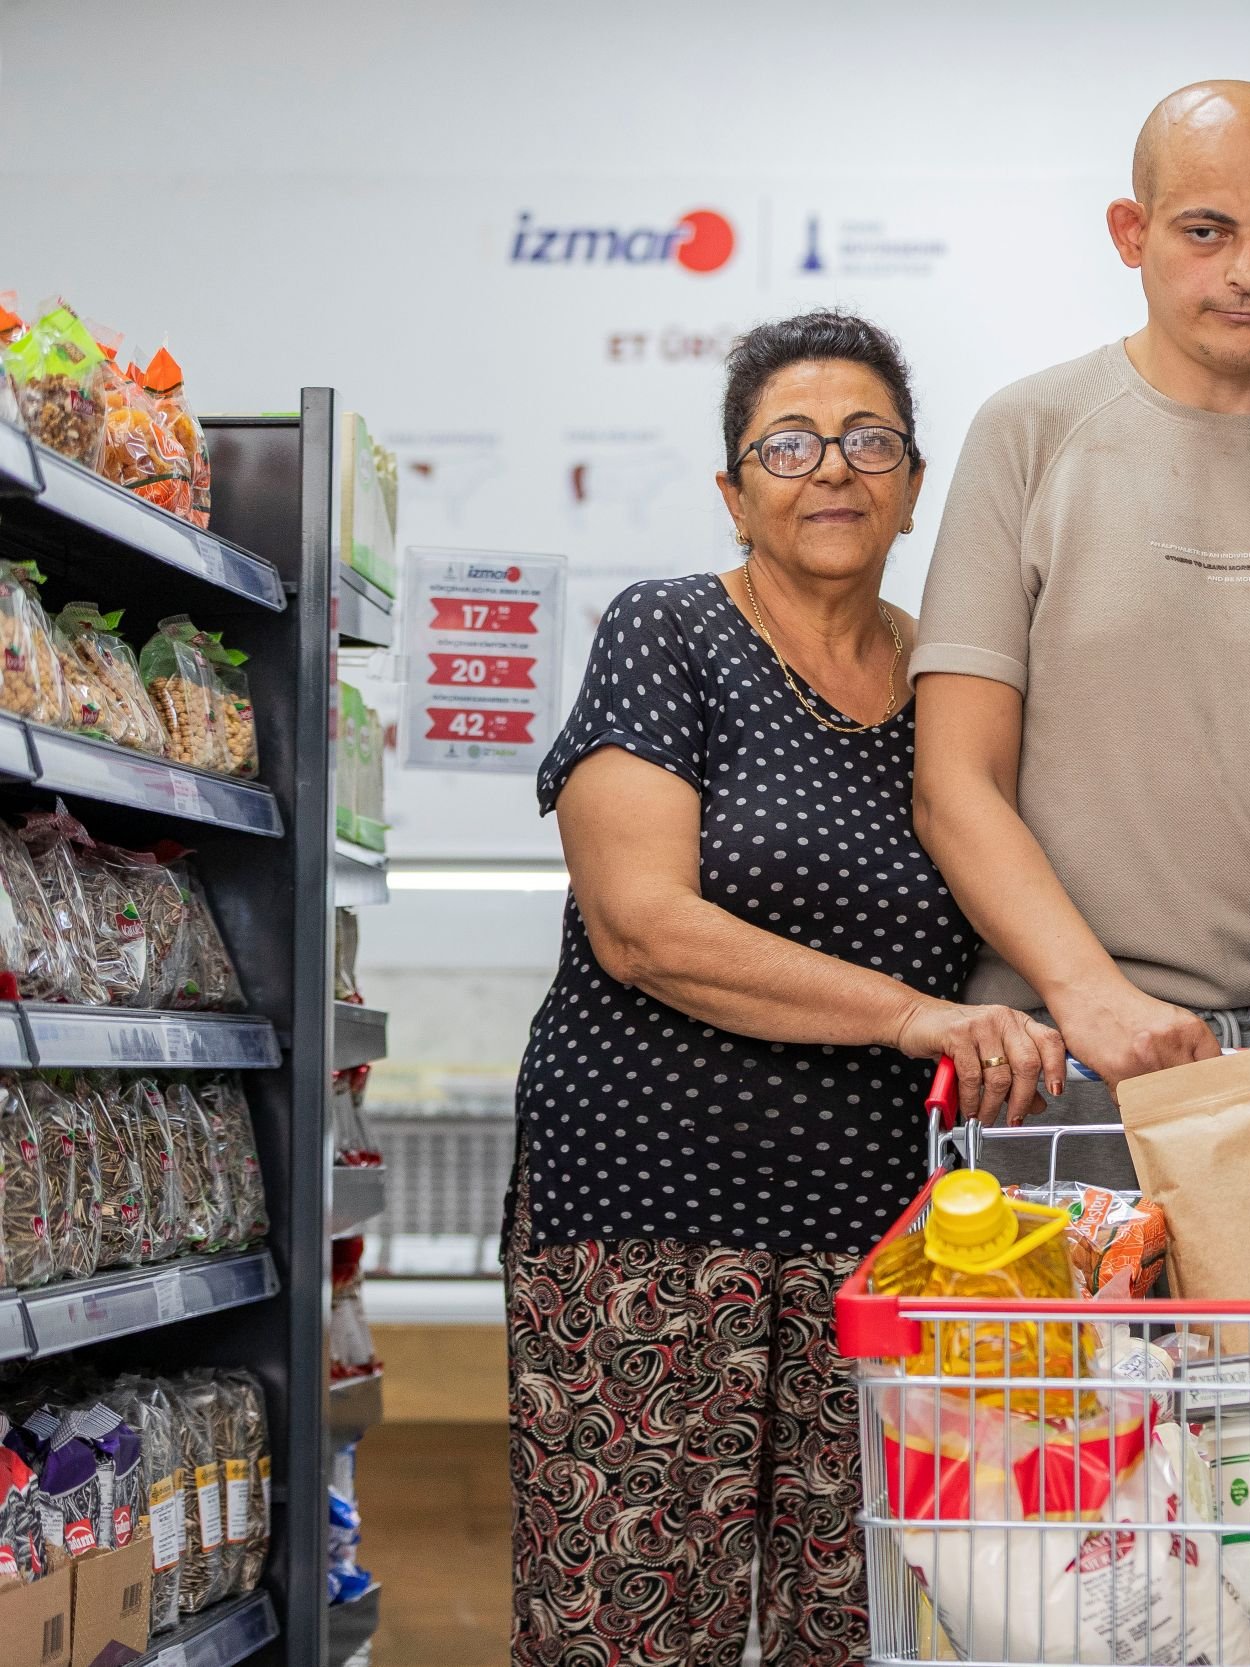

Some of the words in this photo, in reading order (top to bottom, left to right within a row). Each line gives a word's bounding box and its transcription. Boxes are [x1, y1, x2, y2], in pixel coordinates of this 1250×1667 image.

[511, 213, 690, 265] izmar
[608, 335, 646, 363] ET
[468, 565, 510, 580] izmar
[1193, 560, 1203, 568] TO
[1203, 563, 1228, 571] LEARN
[462, 604, 490, 629] 17
[451, 659, 487, 683] 20
[448, 712, 485, 737] 42
